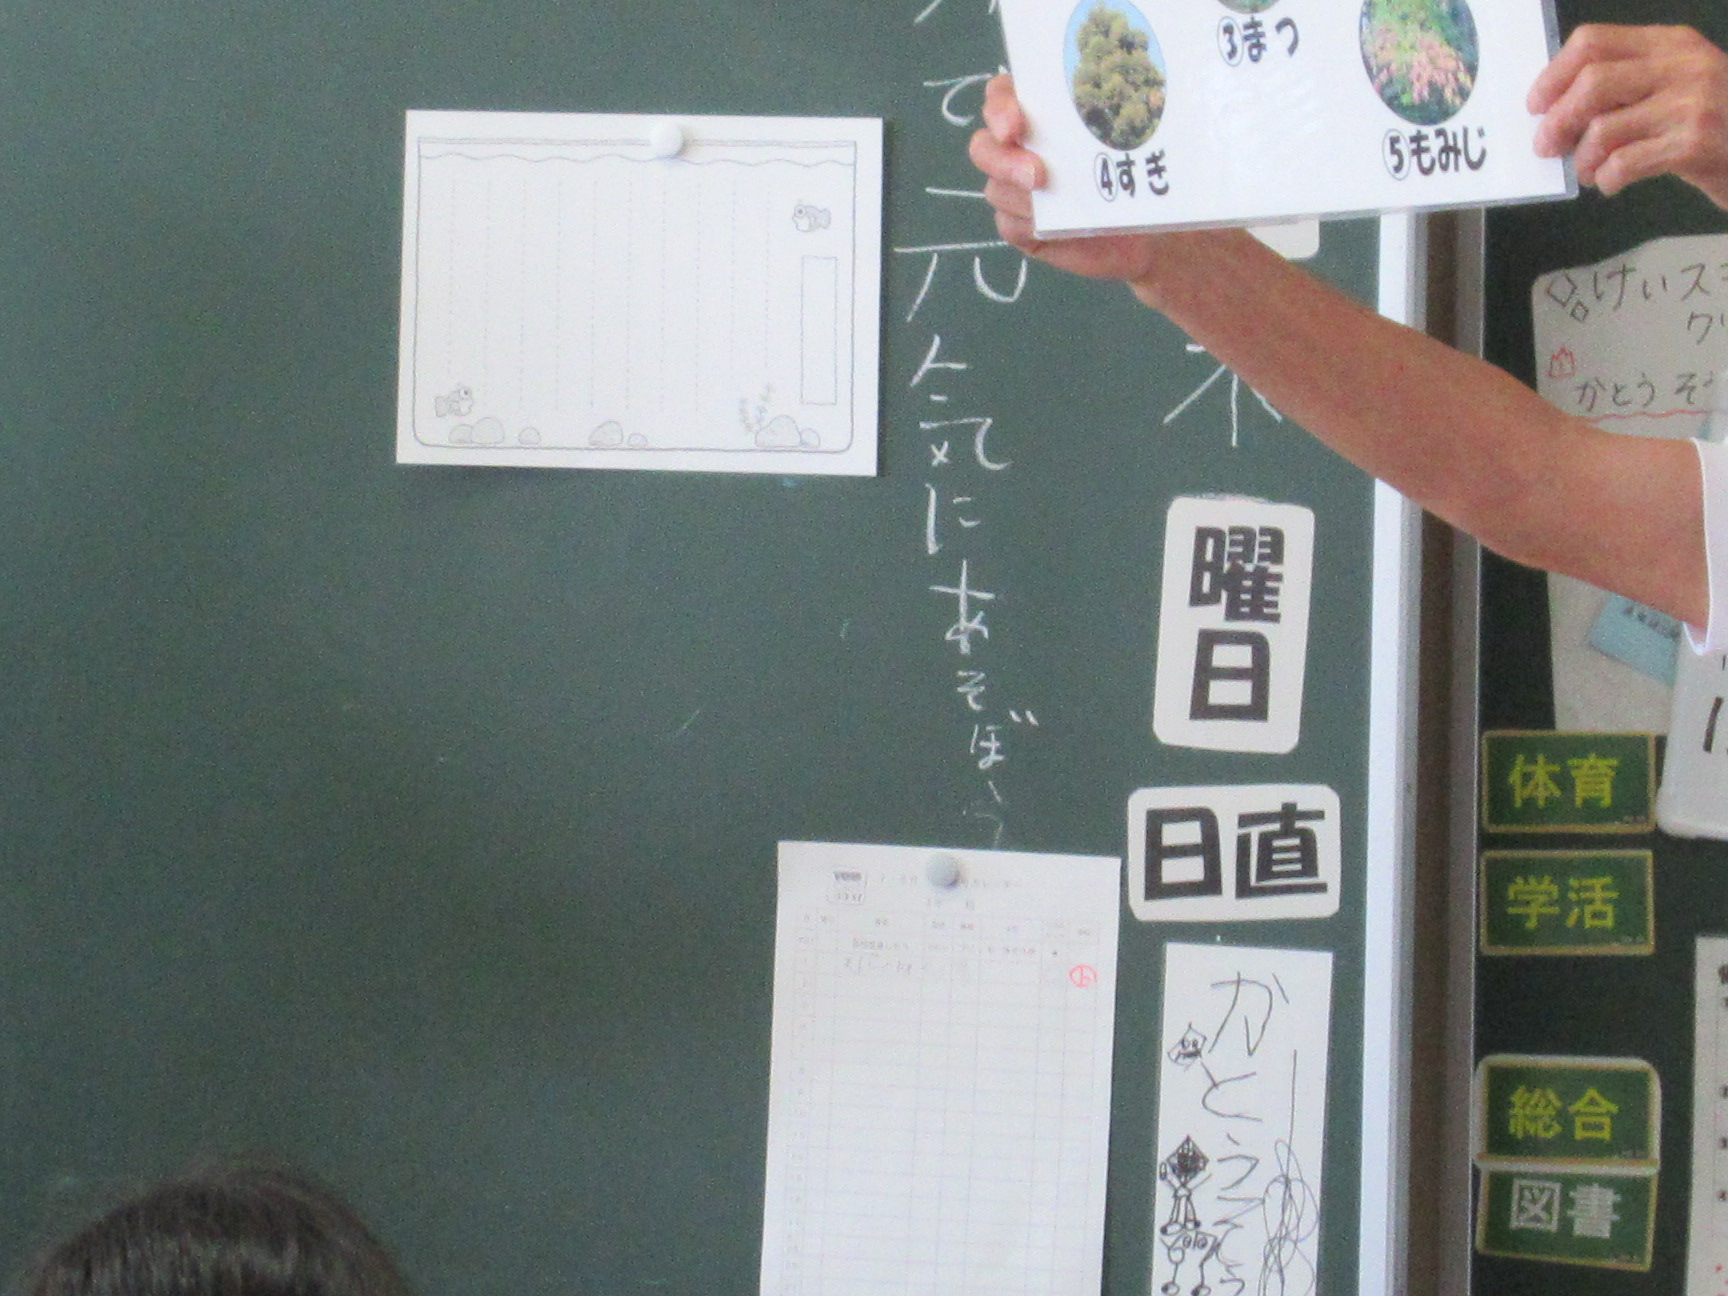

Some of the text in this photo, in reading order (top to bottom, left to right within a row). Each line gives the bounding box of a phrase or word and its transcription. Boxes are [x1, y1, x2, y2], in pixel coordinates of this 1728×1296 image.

[1188, 524, 1286, 723] 曜日
[1509, 754, 1619, 809] 体育
[1143, 803, 1329, 901] 日直
[1508, 875, 1619, 930] 学活
[1509, 1087, 1619, 1141] 総合
[1510, 1182, 1620, 1239] 図書
